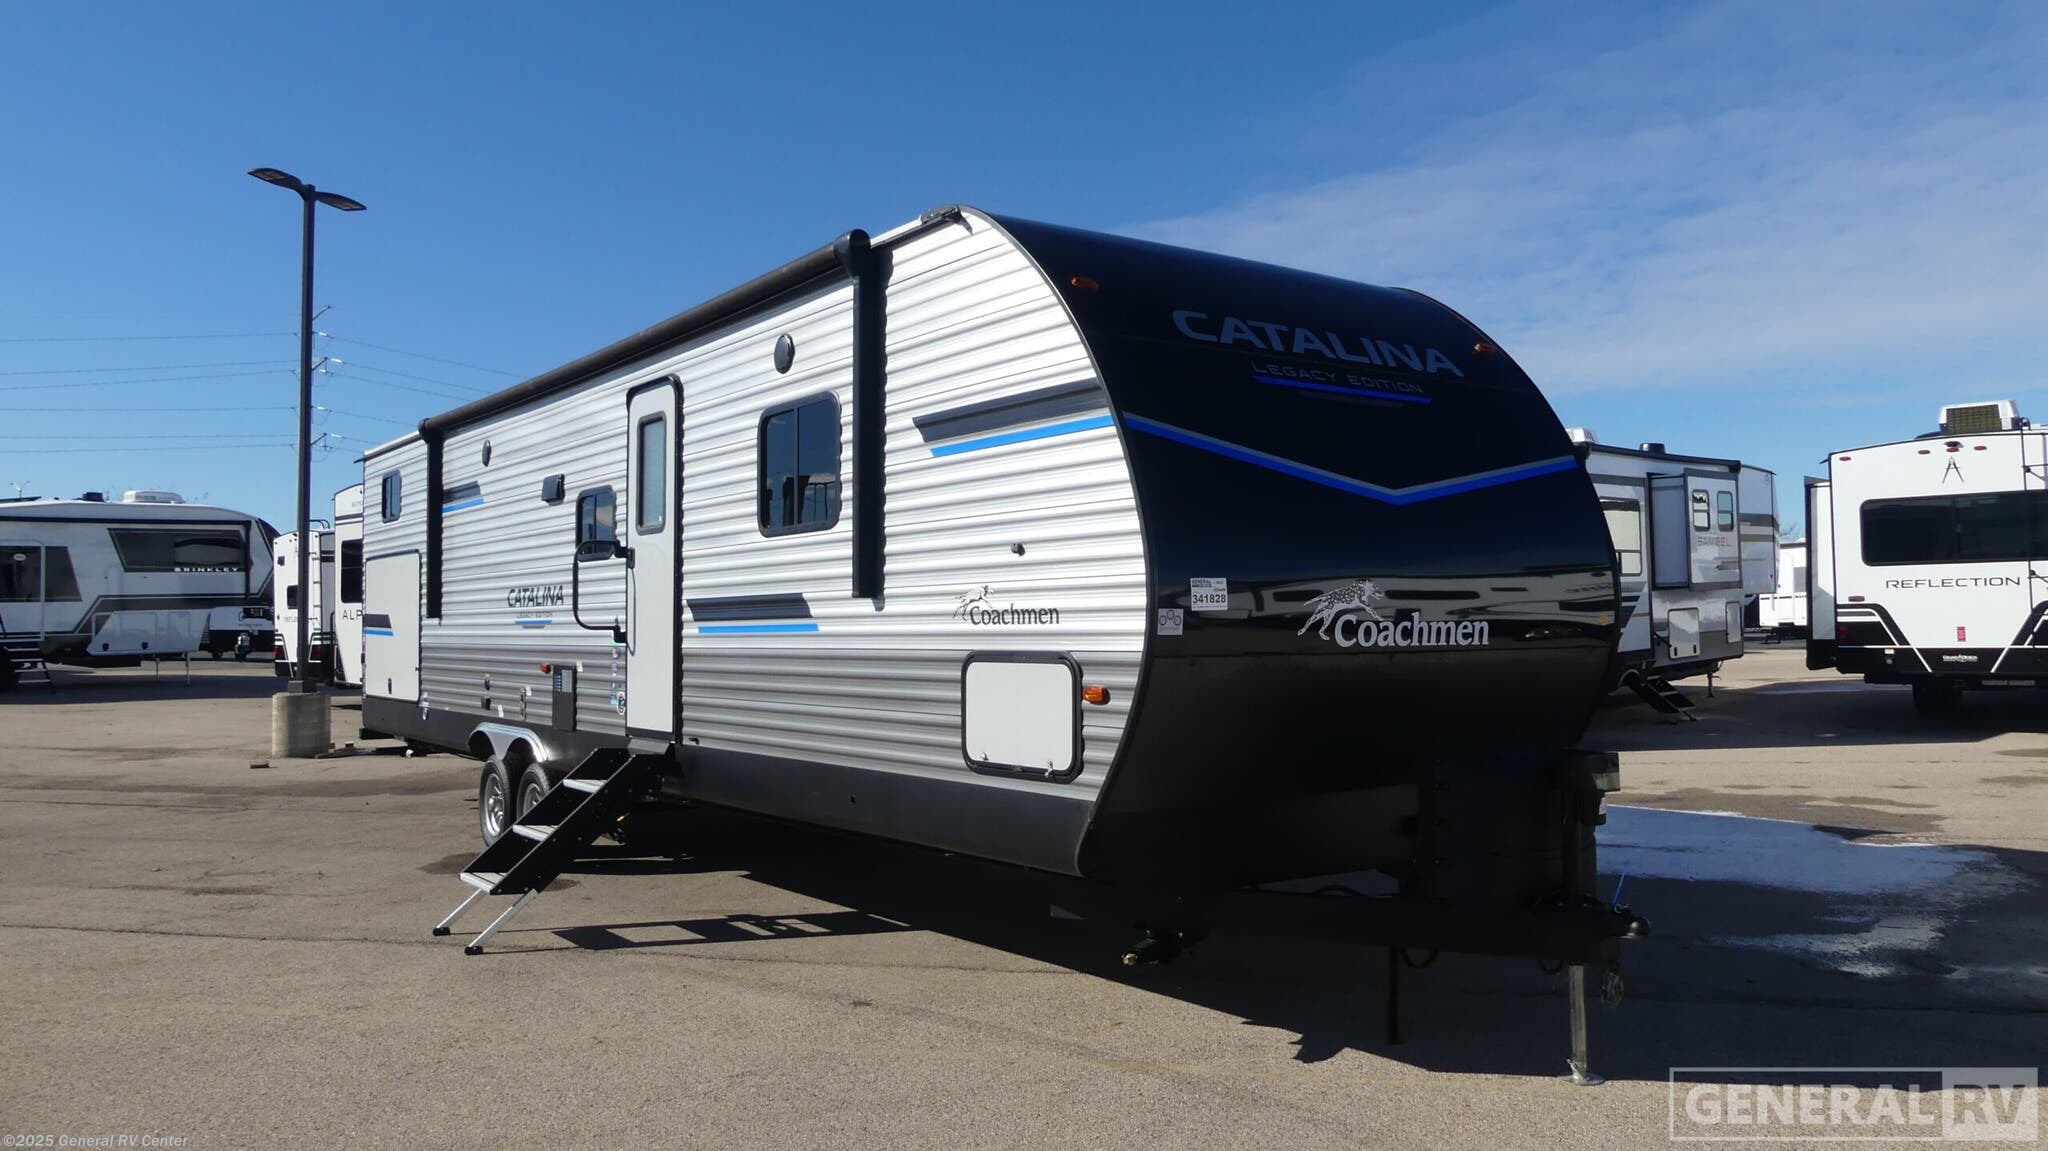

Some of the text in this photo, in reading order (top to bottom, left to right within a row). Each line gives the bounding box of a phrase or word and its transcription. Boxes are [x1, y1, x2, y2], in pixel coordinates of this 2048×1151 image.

[1172, 310, 1465, 377] CATALINA
[1250, 361, 1424, 393] LEGACY EDITION
[1886, 576, 2021, 589] REFLECTION
[507, 585, 564, 608] CATALINA
[1192, 594, 1226, 604] 341828
[969, 603, 1060, 625] Coachmen
[1334, 611, 1490, 648] Coachmen
